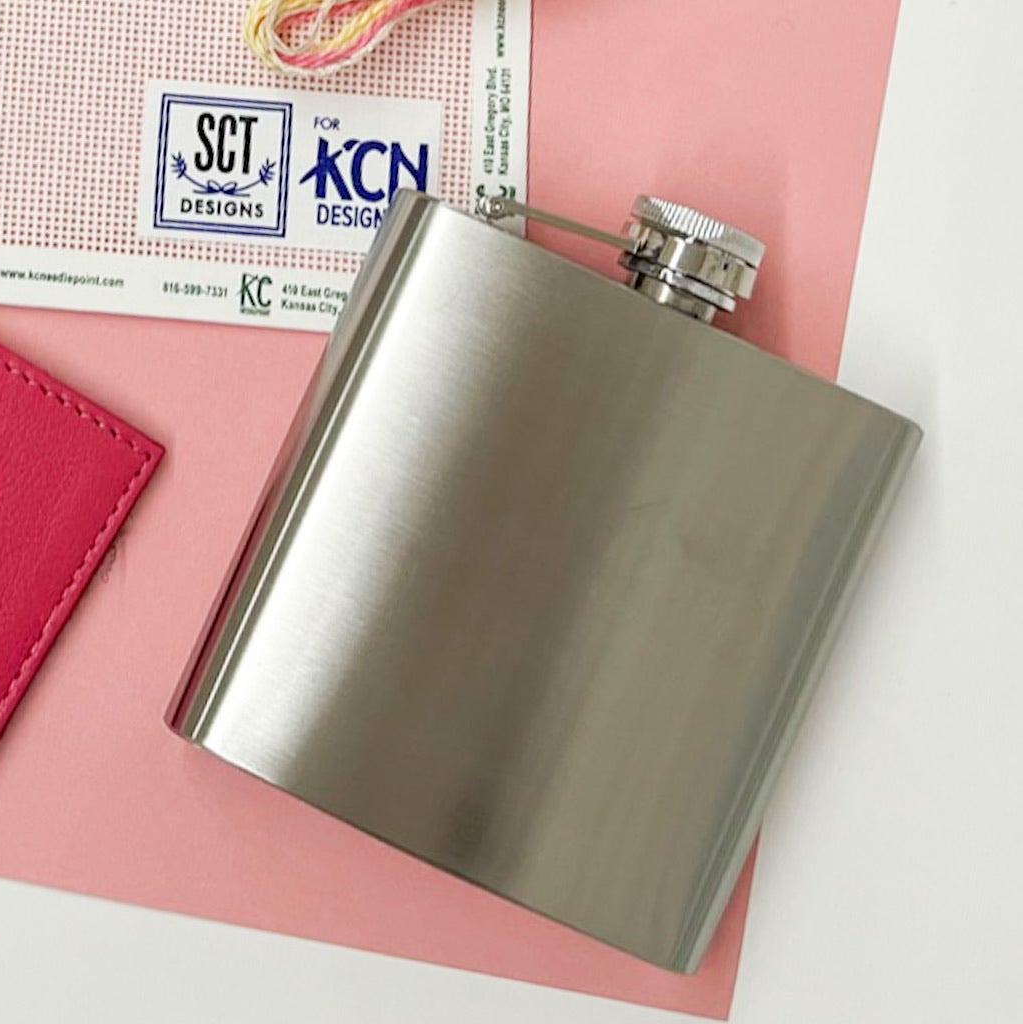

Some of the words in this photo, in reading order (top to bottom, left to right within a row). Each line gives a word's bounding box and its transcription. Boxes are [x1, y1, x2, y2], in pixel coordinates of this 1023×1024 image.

[485, 67, 497, 91] Blvd.
[484, 93, 498, 133] Gregory
[500, 97, 510, 113] MO
[313, 116, 340, 131] FOR
[194, 112, 260, 176] SCT
[483, 134, 495, 156] East
[497, 139, 509, 176] Kansas
[299, 136, 428, 204] KCN
[180, 195, 264, 218] DESIGNS
[0, 270, 124, 287] www.kcneedlepoint.com
[239, 273, 273, 308] KC
[300, 284, 322, 298] East
[281, 299, 316, 312] Kansas
